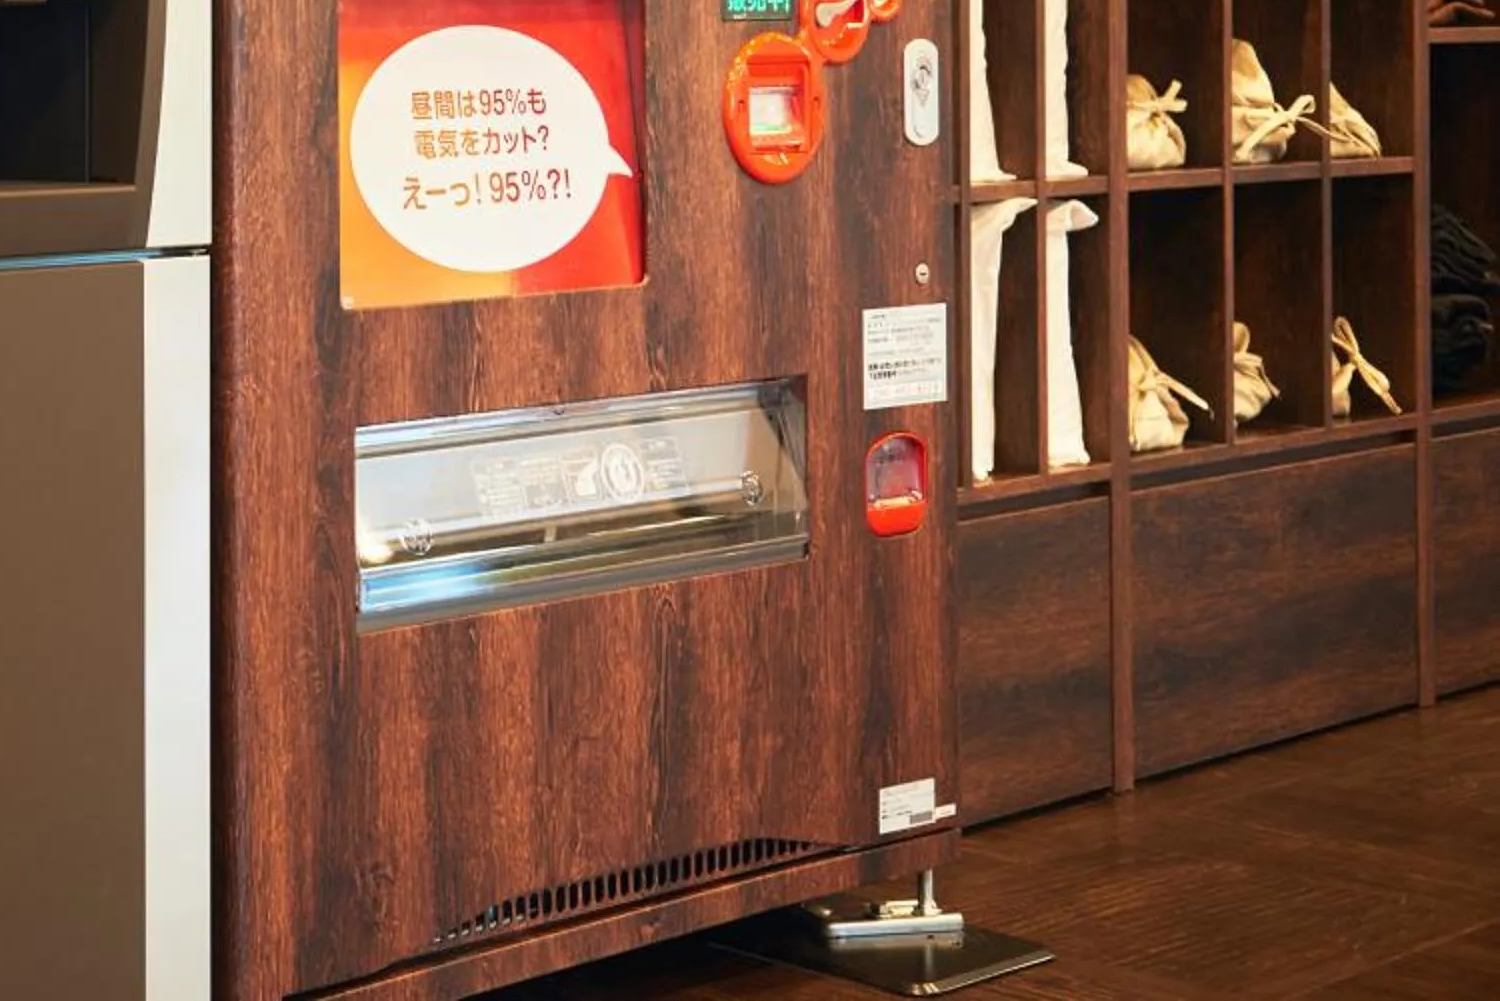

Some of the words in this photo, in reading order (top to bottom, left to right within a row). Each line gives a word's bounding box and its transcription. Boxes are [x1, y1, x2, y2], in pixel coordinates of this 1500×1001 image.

[410, 87, 547, 121] 昼間は95%も
[412, 125, 550, 160] 電気をカット?
